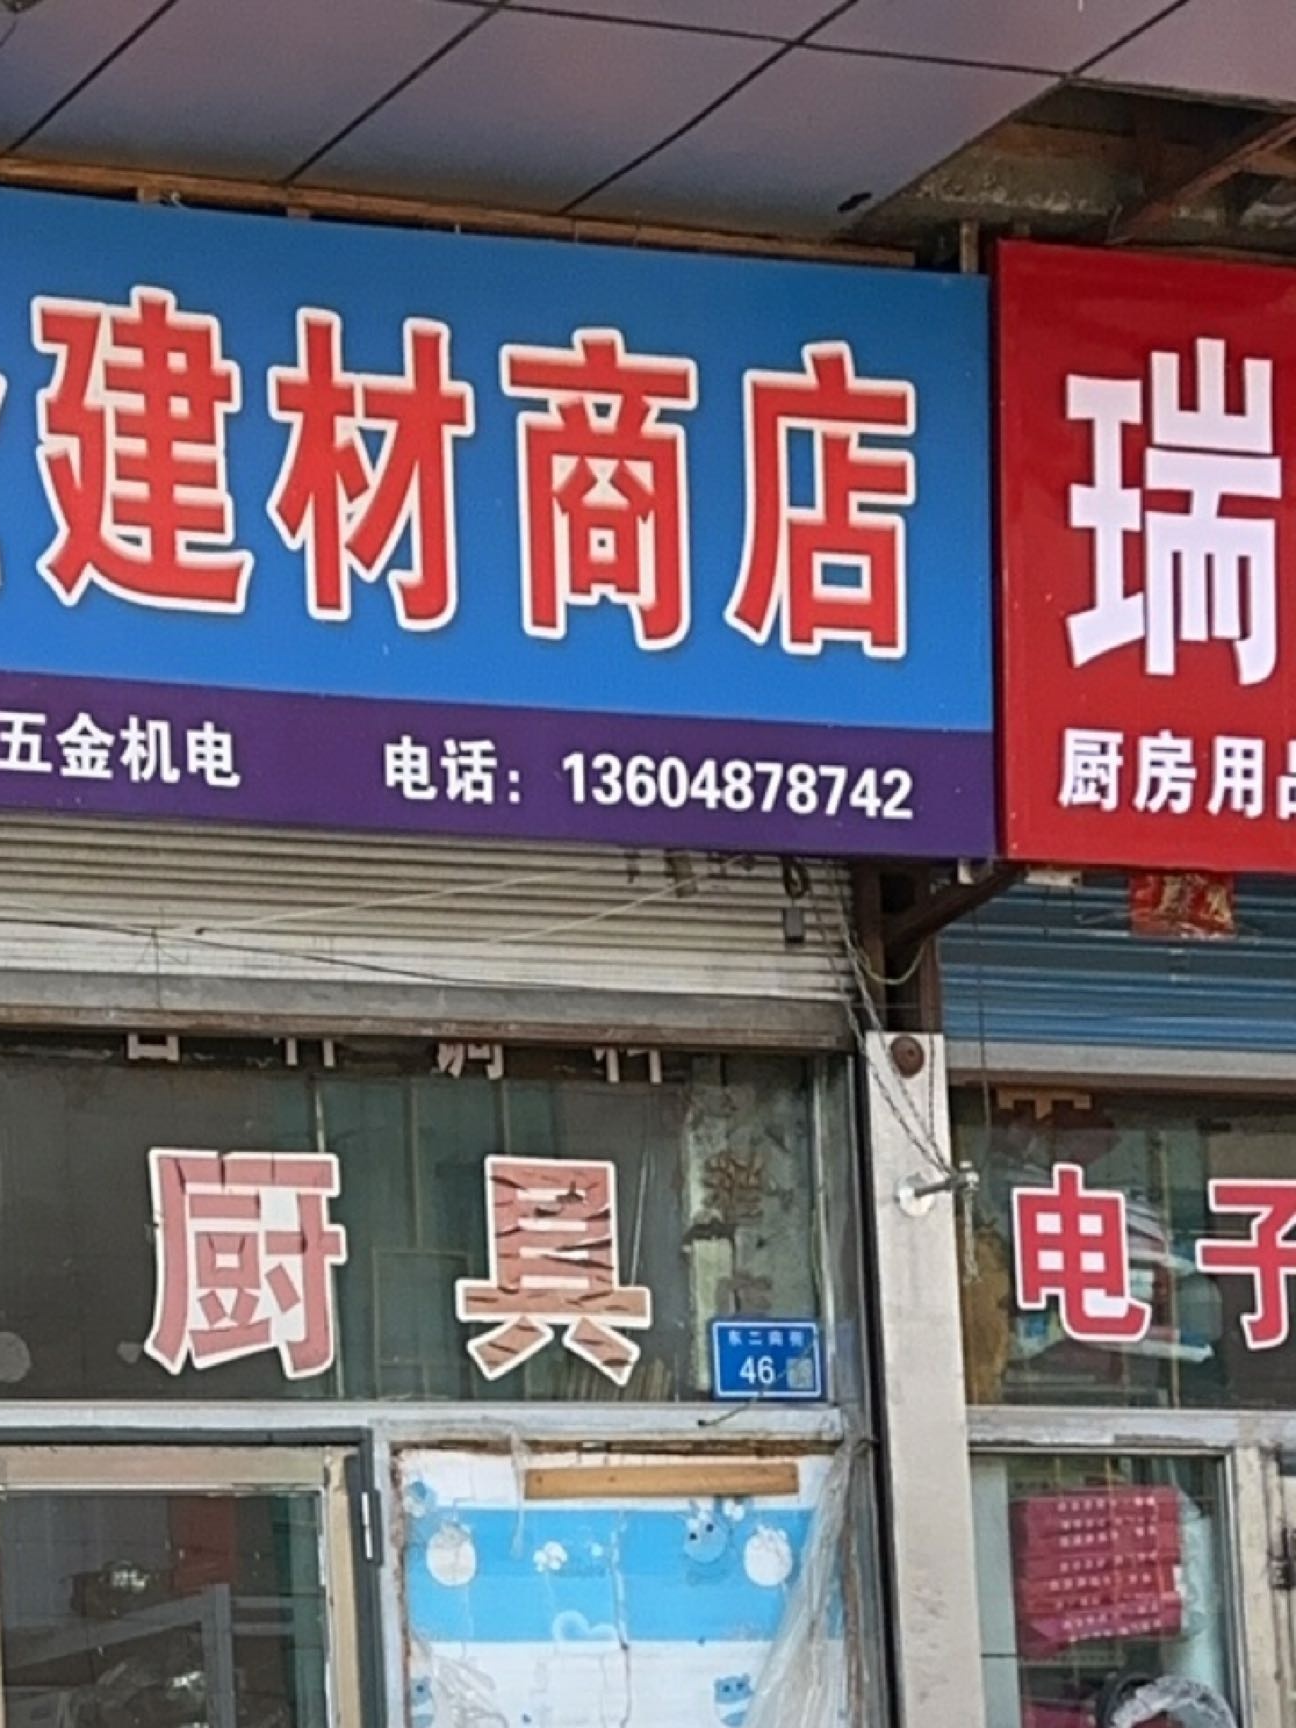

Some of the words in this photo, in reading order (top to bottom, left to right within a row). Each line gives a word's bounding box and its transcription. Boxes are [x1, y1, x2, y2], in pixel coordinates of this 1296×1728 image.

[1066, 337, 1282, 686] 瑞
[562, 753, 914, 820] 13604878742
[144, 1148, 652, 1385] 厨具
[1013, 1164, 1296, 1350] 电子
[738, 1355, 775, 1385] 46
